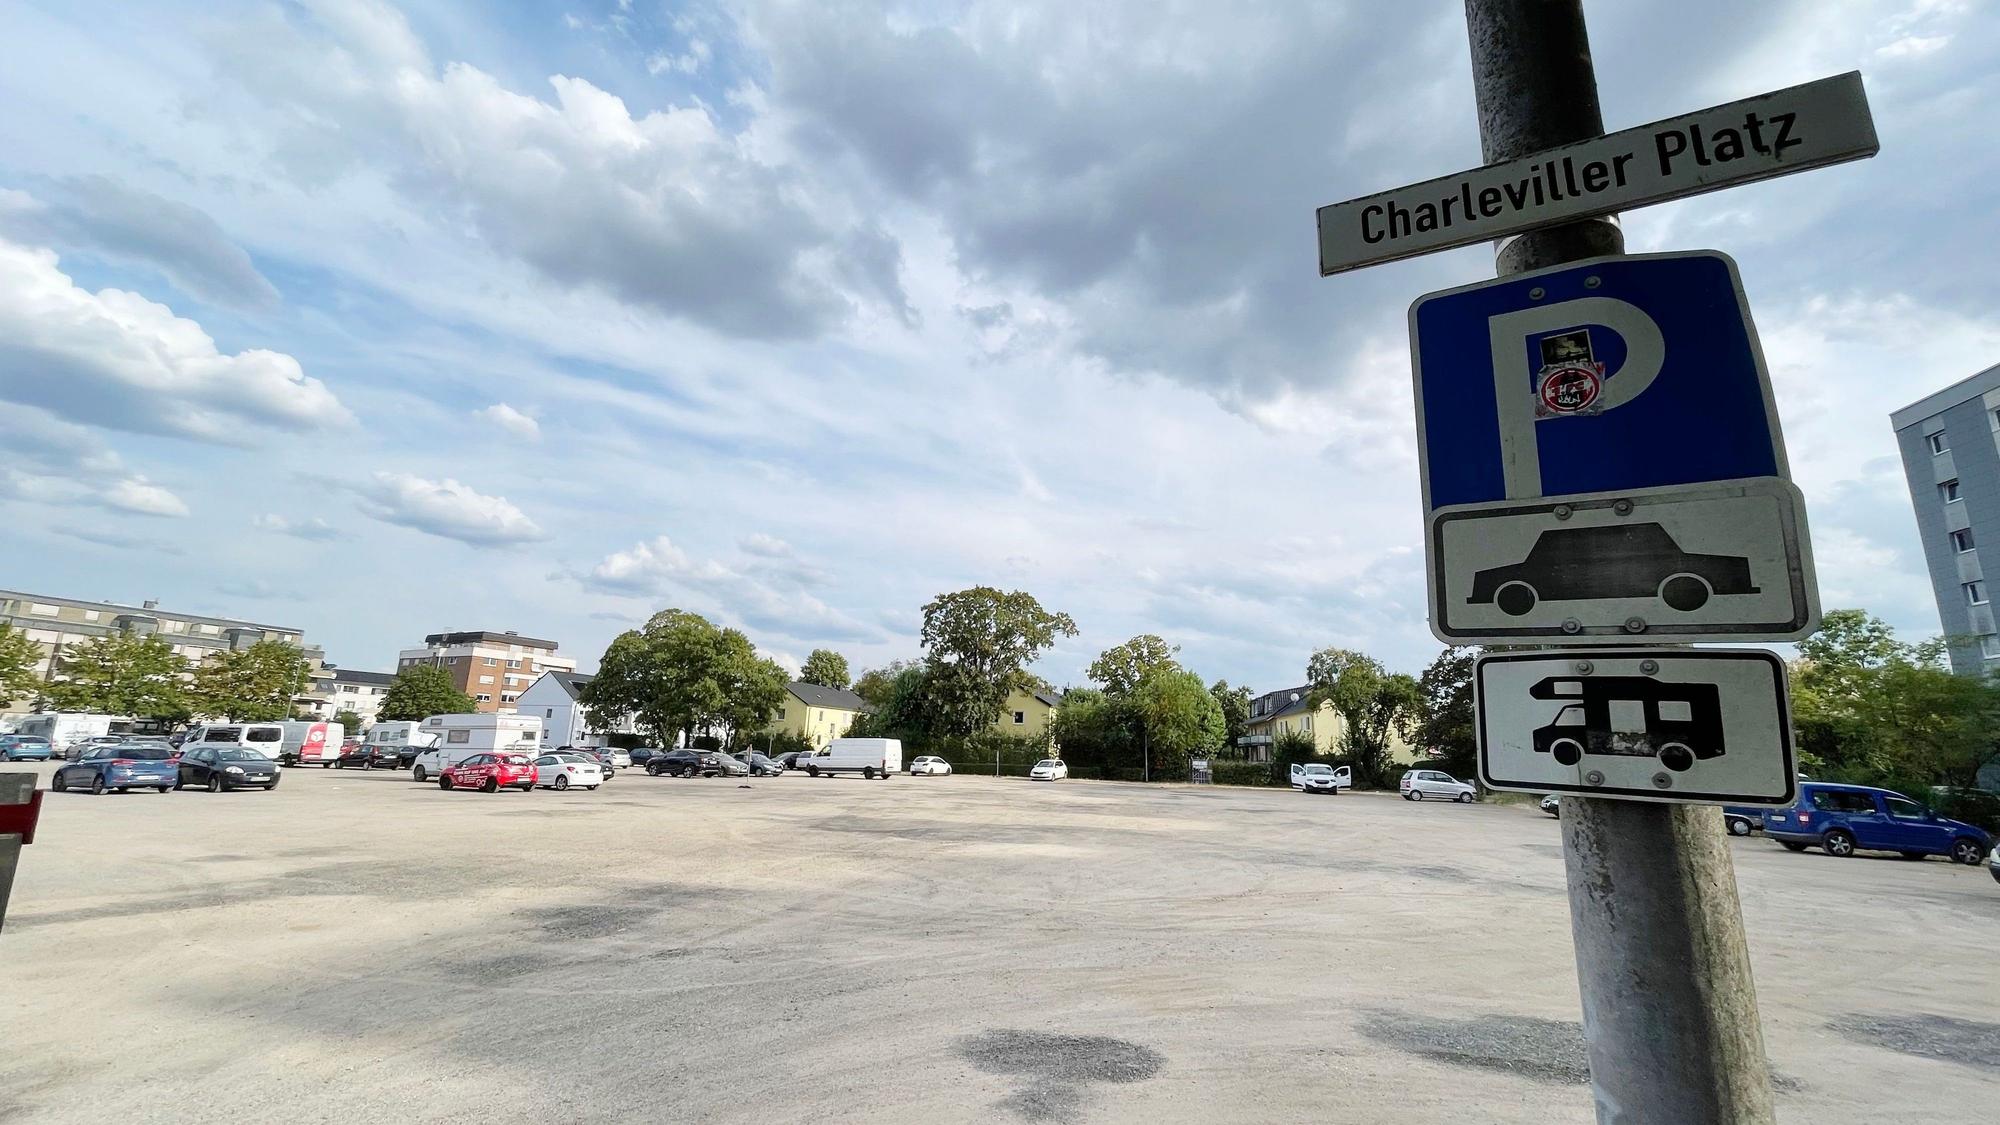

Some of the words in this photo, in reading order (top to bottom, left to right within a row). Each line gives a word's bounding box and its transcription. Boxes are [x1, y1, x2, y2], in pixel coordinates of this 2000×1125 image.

[1361, 153, 1633, 244] Charleviller
[1655, 112, 1802, 176] Platz
[1488, 297, 1665, 500] P
